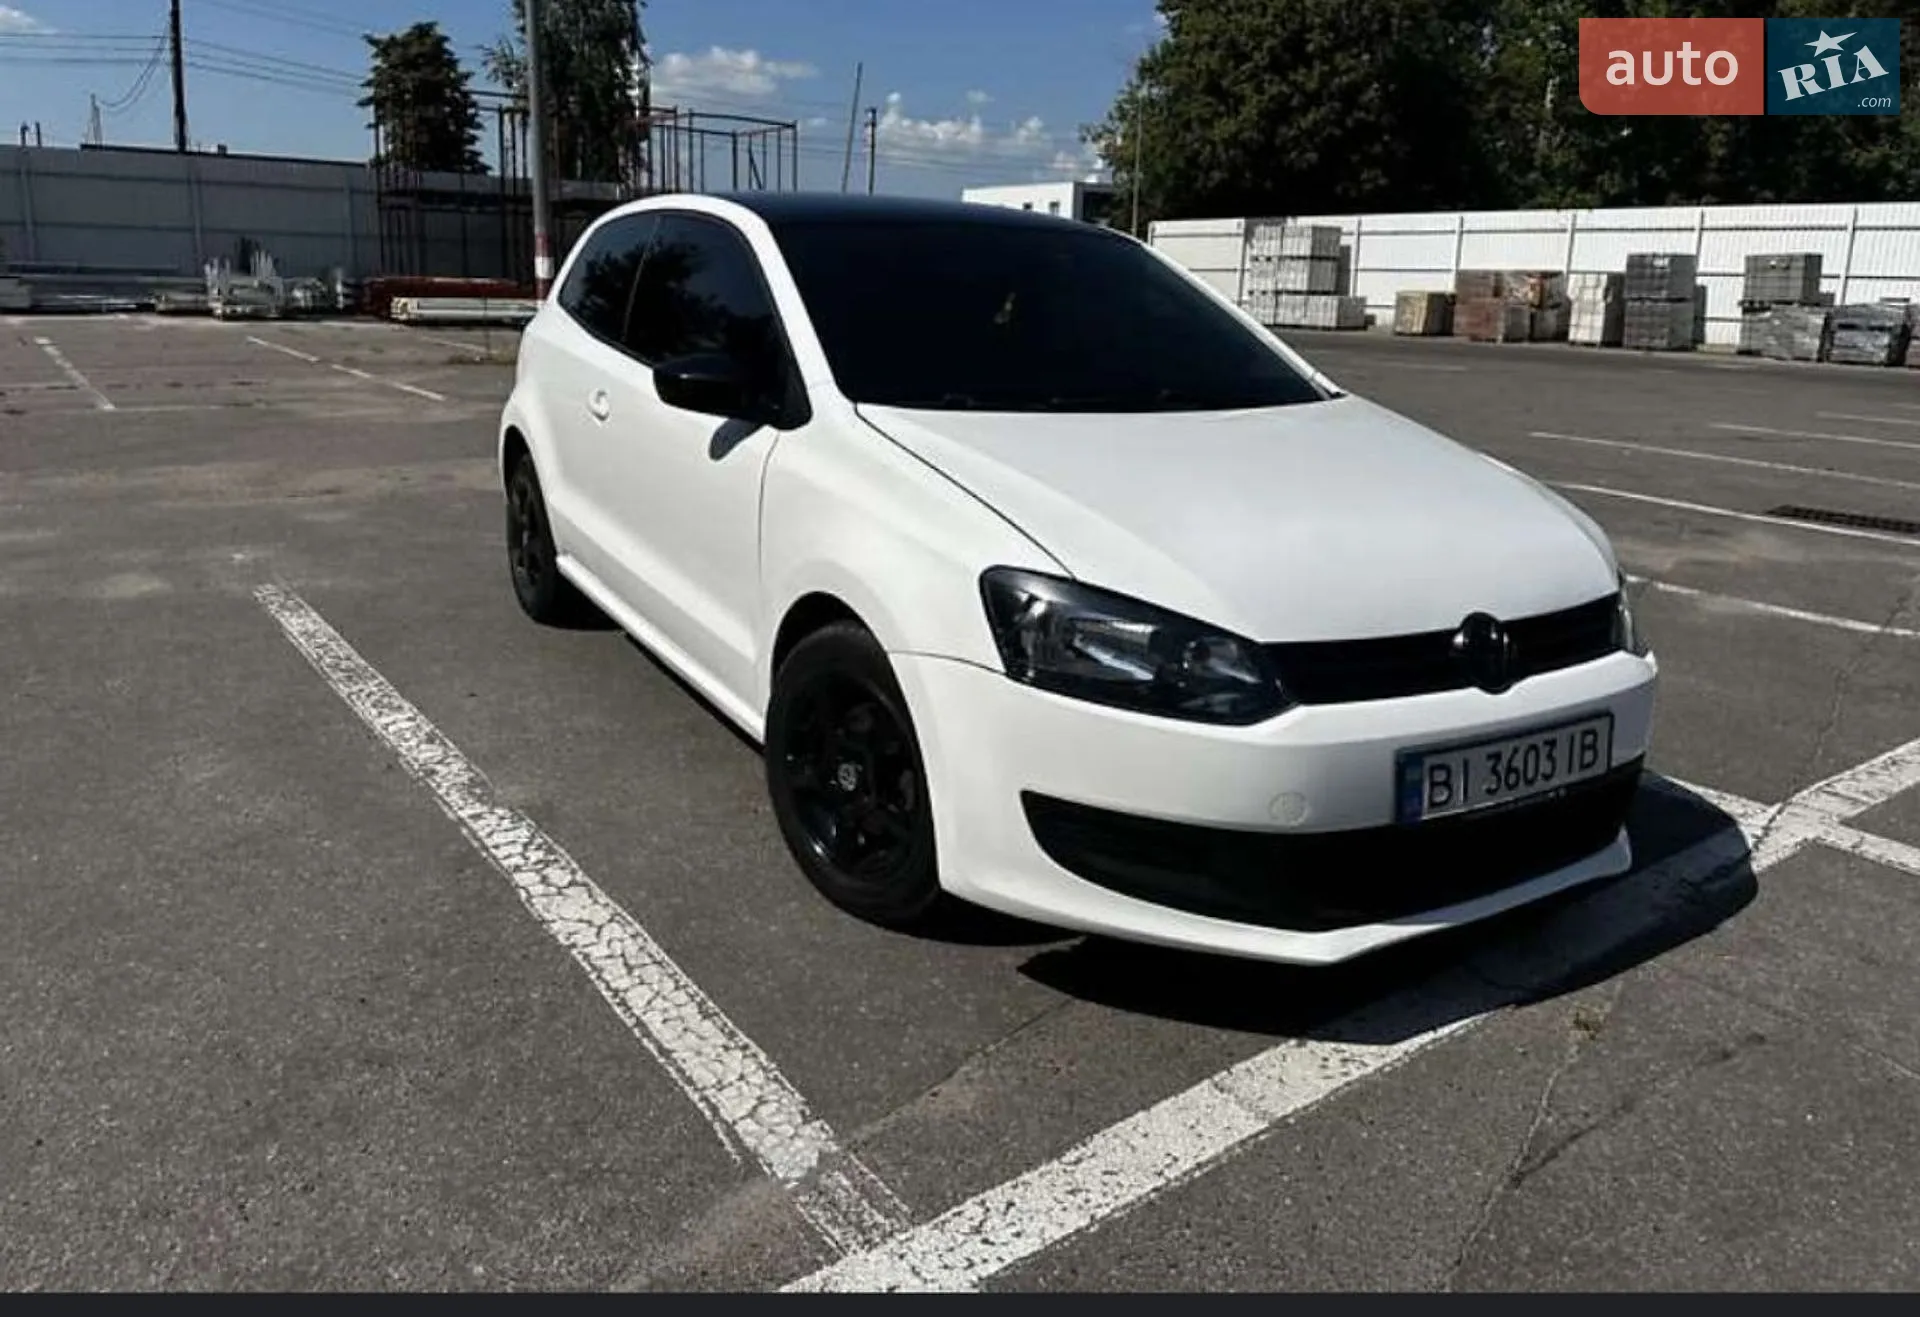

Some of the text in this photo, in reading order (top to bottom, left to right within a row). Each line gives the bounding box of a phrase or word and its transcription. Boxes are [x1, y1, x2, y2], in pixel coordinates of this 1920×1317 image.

[1428, 758, 1470, 808] BI
[1485, 738, 1557, 796] 3603
[1567, 729, 1600, 775] IB
